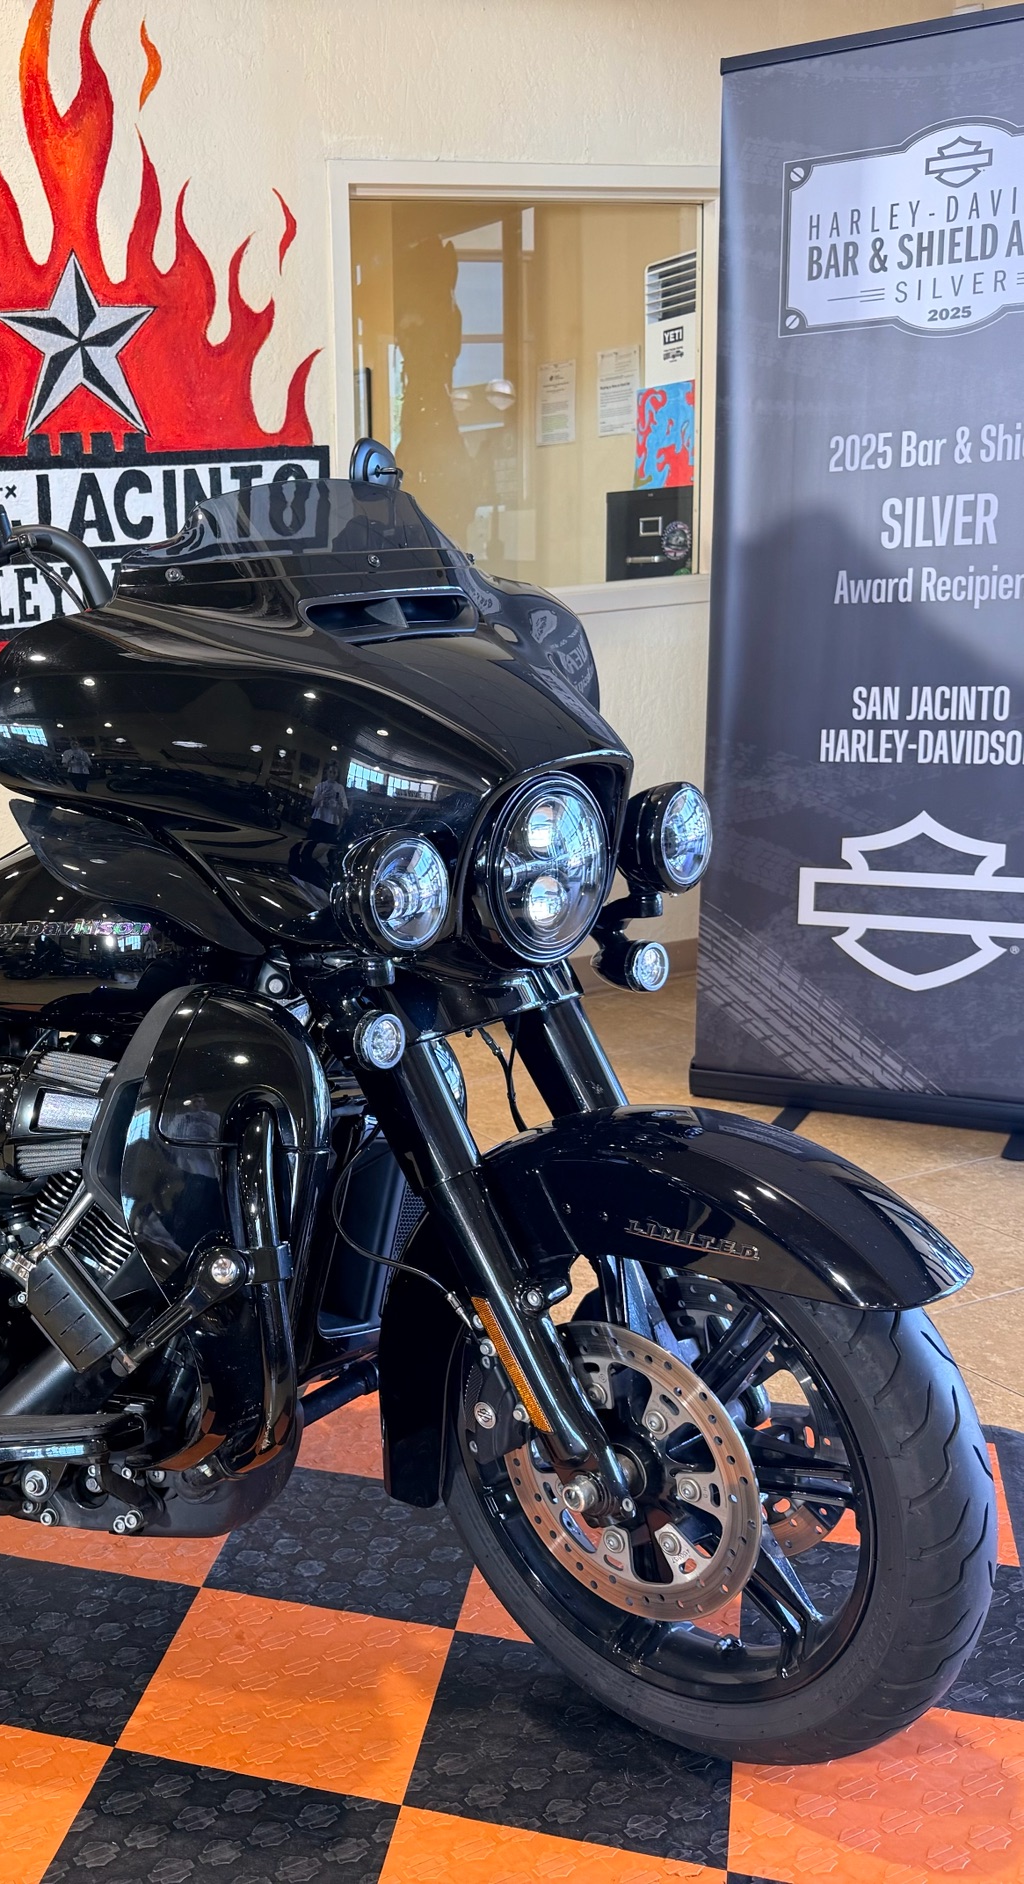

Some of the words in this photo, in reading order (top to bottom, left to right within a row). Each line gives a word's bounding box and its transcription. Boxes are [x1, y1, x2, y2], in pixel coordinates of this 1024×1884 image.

[808, 186, 1018, 241] HARLEY-DAVI
[807, 240, 860, 282] BAR
[868, 236, 889, 274] &
[897, 223, 999, 271] SHIELD
[1004, 219, 1024, 258] A
[894, 269, 1007, 304] SILVER
[927, 305, 973, 322] 2025
[663, 327, 683, 344] YETI
[828, 431, 893, 473] 2025
[900, 429, 947, 468] Bar
[953, 425, 973, 465] &
[979, 421, 1024, 463] Shi
[880, 492, 999, 550] SILVER
[833, 566, 914, 605] Award
[851, 685, 901, 721] SAN
[906, 685, 1011, 722] JACINTO
[819, 728, 1024, 766] HARLEY-DAVIDSO
